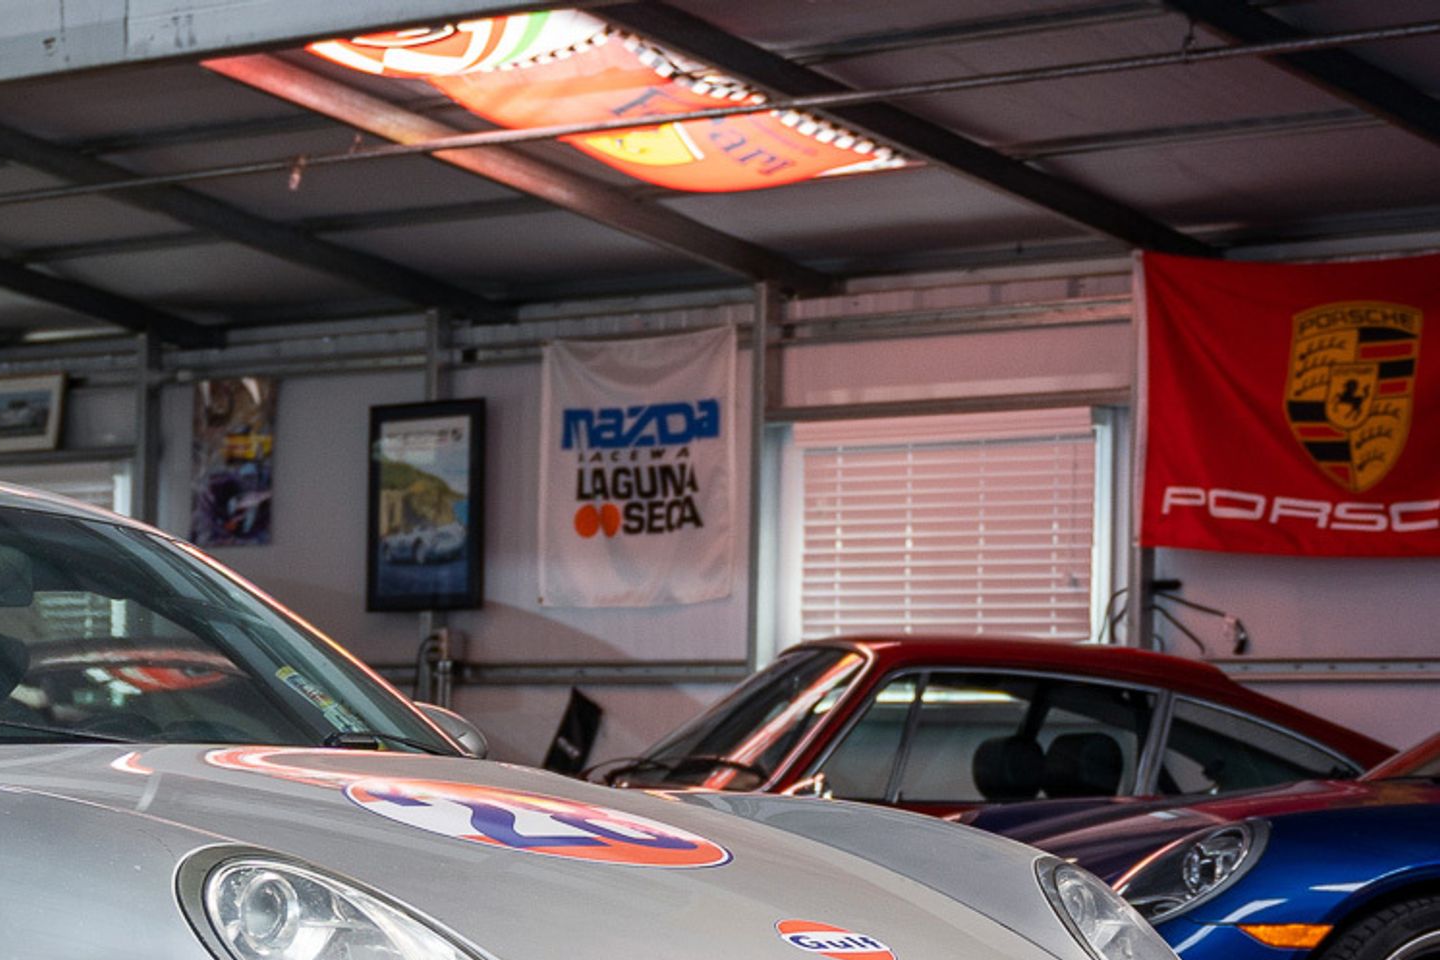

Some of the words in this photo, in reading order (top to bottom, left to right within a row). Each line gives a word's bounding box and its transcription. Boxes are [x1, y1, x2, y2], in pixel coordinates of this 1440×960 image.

[1299, 308, 1414, 332] PORSCHE
[576, 464, 699, 501] LAGUNA
[622, 496, 704, 535] SECA
[789, 935, 881, 950] Gulf
